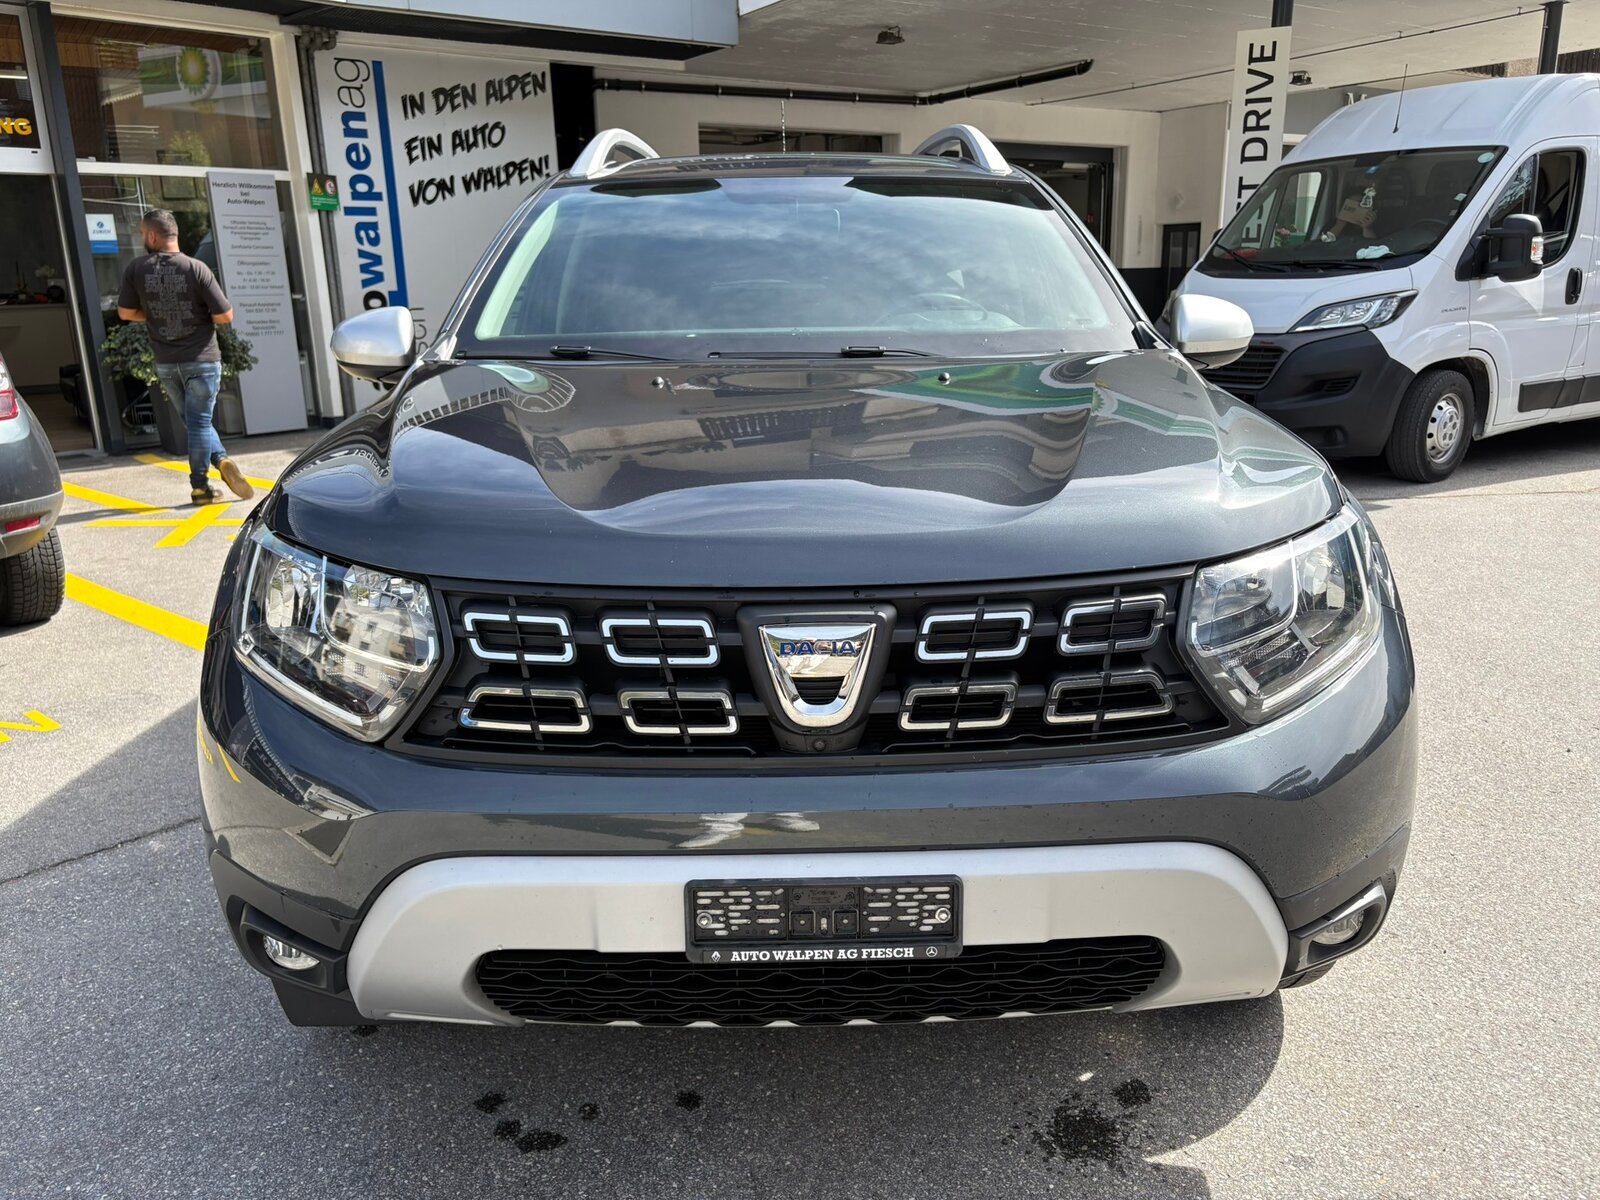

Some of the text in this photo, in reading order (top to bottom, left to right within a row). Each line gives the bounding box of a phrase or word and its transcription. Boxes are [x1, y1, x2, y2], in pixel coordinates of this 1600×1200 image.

[401, 71, 547, 121] IN DEN ALPEN
[1240, 40, 1278, 165] DRIVE
[404, 121, 506, 166] EIN AUTO
[212, 182, 237, 190] Herzlich
[227, 198, 266, 206] Auto-Walpen
[334, 57, 384, 313] owalpenag
[408, 154, 550, 208] VON WALPEN!
[779, 640, 857, 656] DACIA
[731, 947, 914, 962] AUTO WALPEN AG FIESCH
